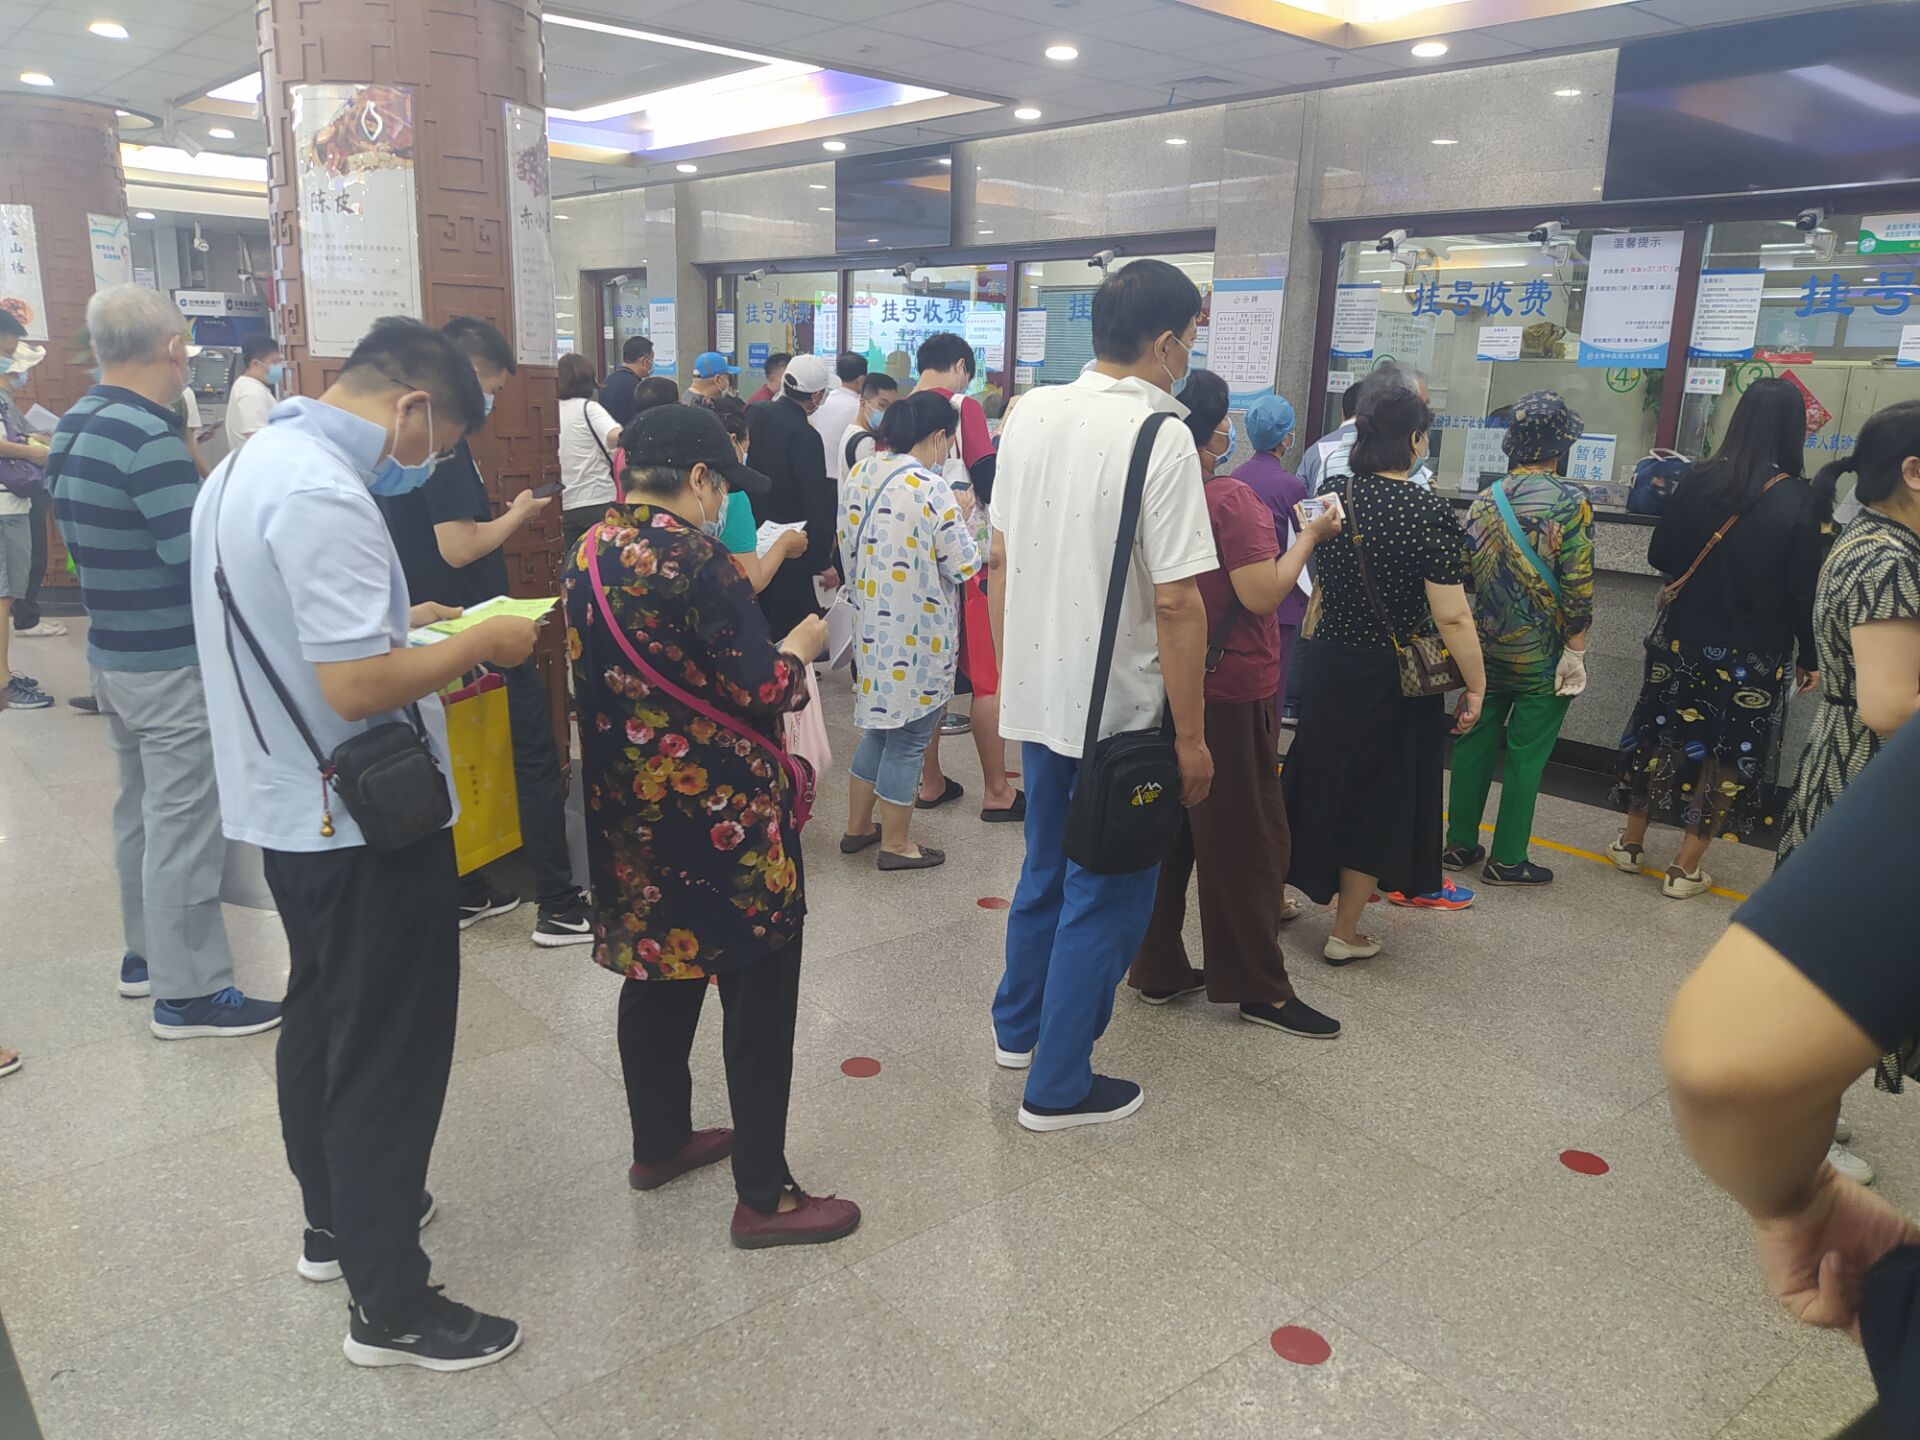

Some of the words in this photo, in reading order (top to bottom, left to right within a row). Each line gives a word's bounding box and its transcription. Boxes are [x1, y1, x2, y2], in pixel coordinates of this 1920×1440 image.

[311, 188, 354, 214] 陈皮
[1613, 236, 1662, 249] 温馨提示
[1411, 279, 1552, 318] 挂号收费
[1794, 271, 1920, 317] 挂号
[745, 302, 812, 324] 挂号收费
[881, 299, 965, 324] 挂号收费
[1576, 445, 1607, 462] 暂停
[1572, 464, 1603, 480] 服务
